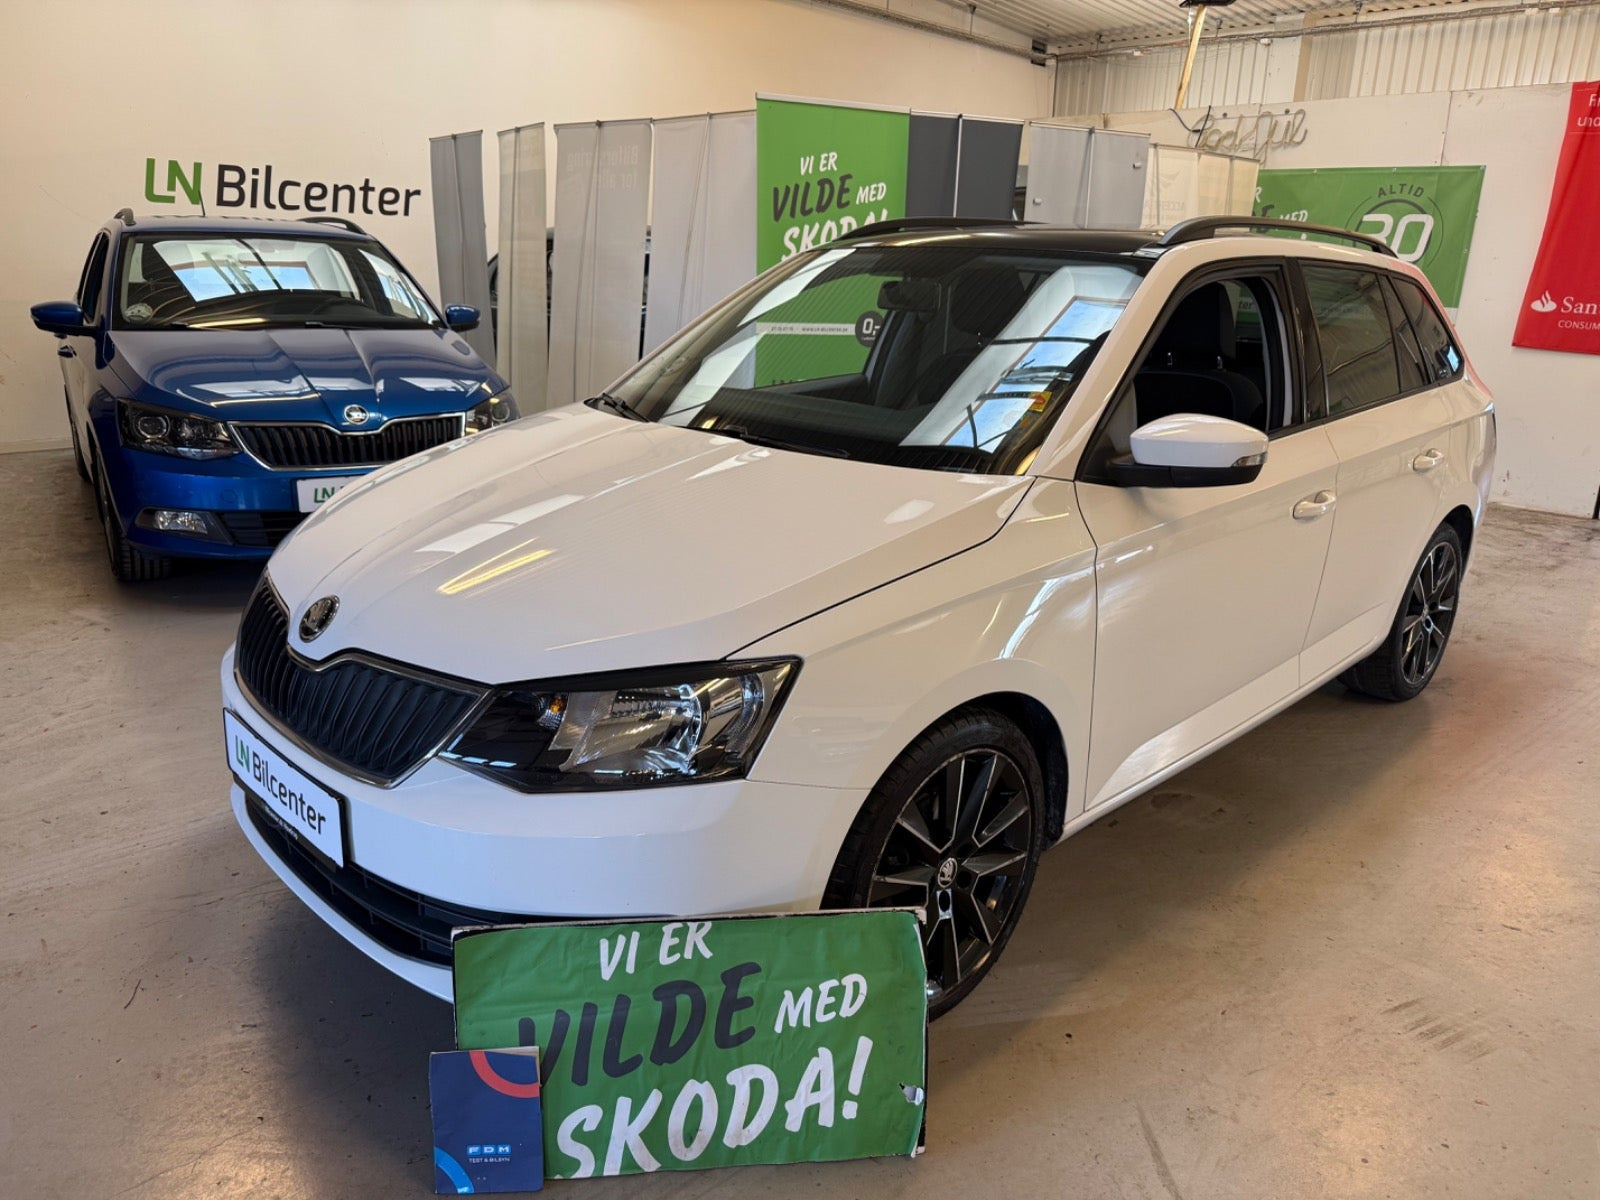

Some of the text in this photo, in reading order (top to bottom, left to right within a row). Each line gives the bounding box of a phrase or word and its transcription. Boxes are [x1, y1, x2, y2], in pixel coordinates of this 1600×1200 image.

[144, 157, 421, 217] LN Bilcenter
[800, 152, 838, 176] VI ER
[1378, 183, 1425, 198] ALTID
[773, 173, 887, 223] VILDE MED
[314, 486, 335, 503] LN
[235, 735, 250, 773] LN
[253, 750, 326, 835] Bilcenter
[599, 921, 713, 981] VI ER
[518, 962, 868, 1087] VILDE MED
[553, 1035, 873, 1180] SKODA!
[468, 1146, 510, 1154] FDM
